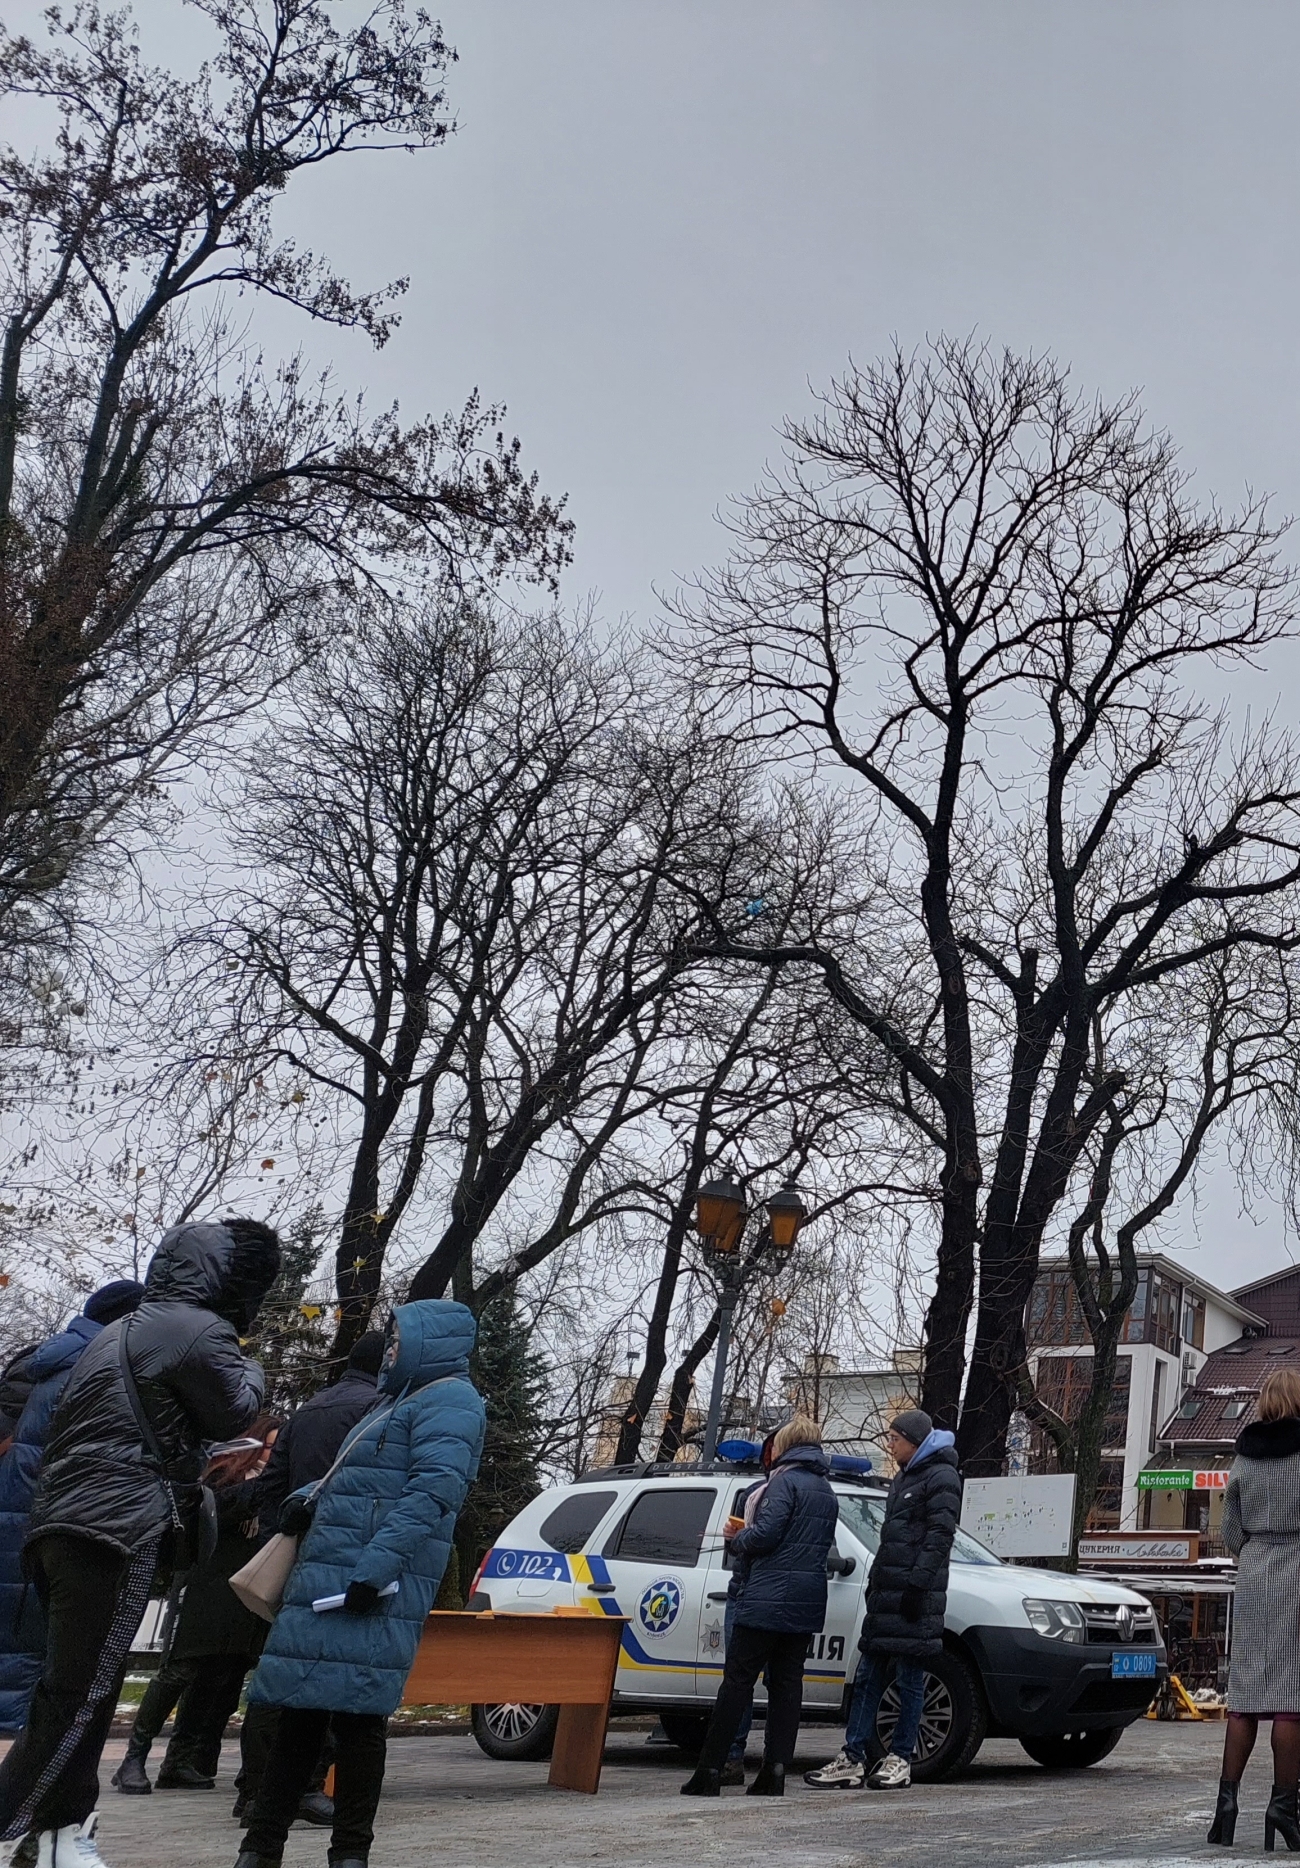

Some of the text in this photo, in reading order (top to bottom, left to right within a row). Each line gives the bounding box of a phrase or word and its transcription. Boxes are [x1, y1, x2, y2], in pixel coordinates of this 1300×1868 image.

[652, 1463, 717, 1471] DUSTER
[1140, 1474, 1190, 1486] Ristorante
[1079, 1545, 1121, 1554] ЦУКЕРНЯ
[517, 1555, 553, 1575] 102
[1133, 1655, 1152, 1672] 0809
